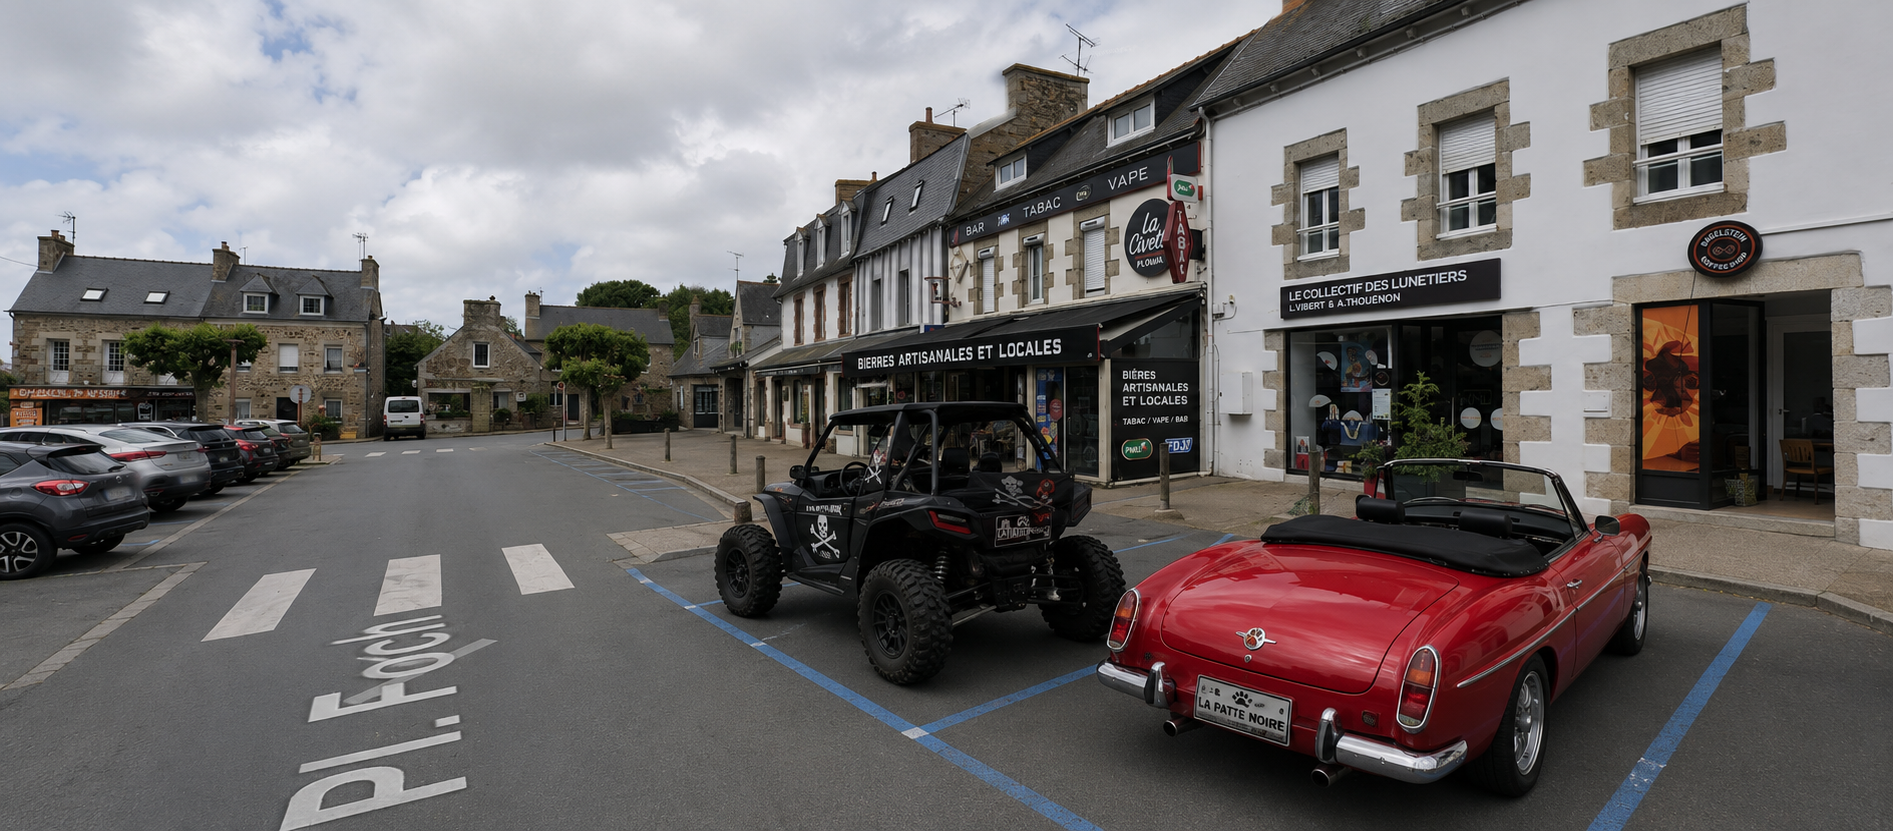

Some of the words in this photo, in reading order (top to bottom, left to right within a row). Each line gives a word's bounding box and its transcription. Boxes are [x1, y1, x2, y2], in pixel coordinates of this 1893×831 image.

[966, 221, 985, 237] BAR
[1022, 196, 1061, 218] TABAC
[1107, 166, 1149, 191] VAPE
[1176, 209, 1187, 275] TABAC
[1289, 290, 1302, 302] LE
[1302, 282, 1363, 300] COLLECTIF
[1365, 279, 1389, 292] DES
[1391, 269, 1468, 290] LUNETIERS
[857, 353, 895, 370] BIERRES
[898, 346, 973, 366] ARTISANALES
[977, 344, 993, 360] ET
[999, 338, 1062, 359] LOCALES
[1122, 383, 1189, 392] ARTISANALES
[1122, 396, 1136, 406] ET
[1140, 395, 1188, 406] LOCALES
[1122, 417, 1146, 425] TABAC
[1152, 416, 1169, 424] VAPE
[1198, 696, 1211, 710] LA
[1213, 702, 1246, 720] PATTE
[1248, 712, 1285, 732] NOIRE
